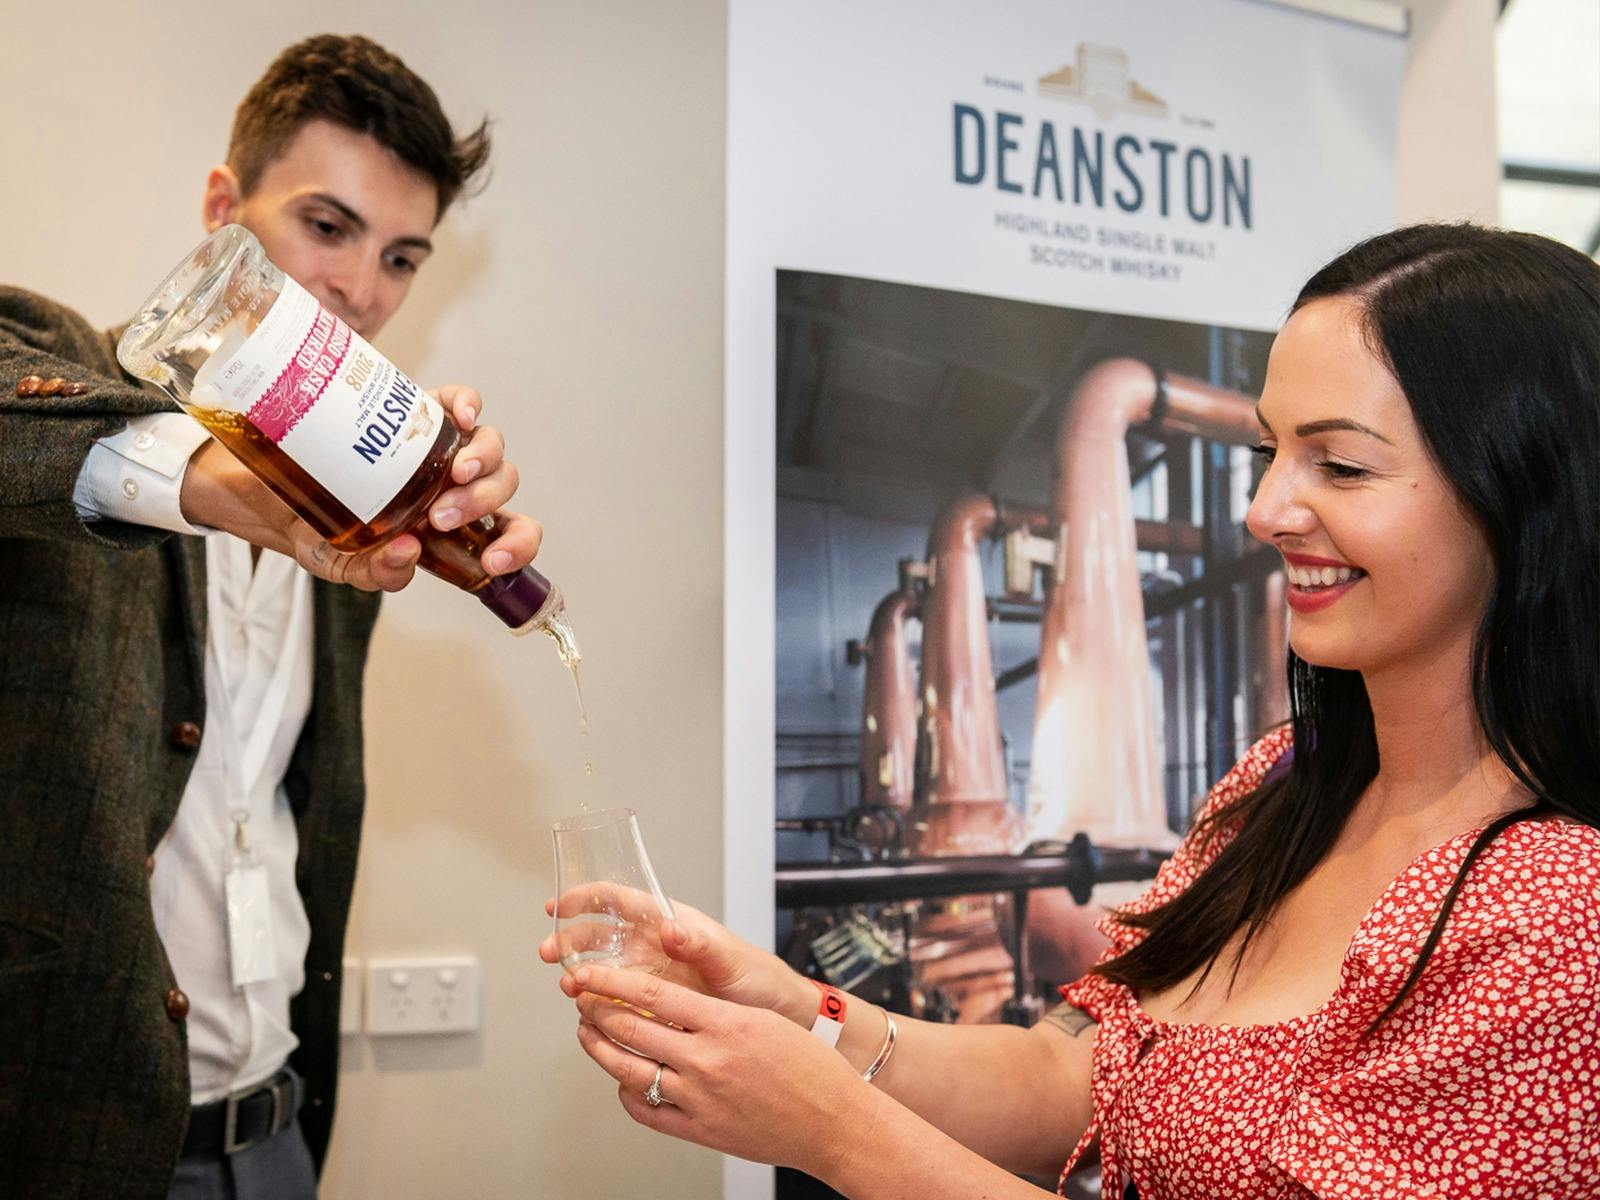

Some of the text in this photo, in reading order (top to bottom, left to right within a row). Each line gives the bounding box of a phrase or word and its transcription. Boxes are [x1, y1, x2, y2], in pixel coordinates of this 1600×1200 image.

[953, 102, 1252, 230] DEANSTON
[994, 211, 1216, 261] HIGHLAND SINGLE MALT
[1030, 245, 1182, 281] SCOTCH WHISKY
[297, 353, 337, 399] CASK
[343, 351, 375, 392] 2008
[352, 370, 416, 464] EANSTON
[354, 407, 370, 428] MALT
